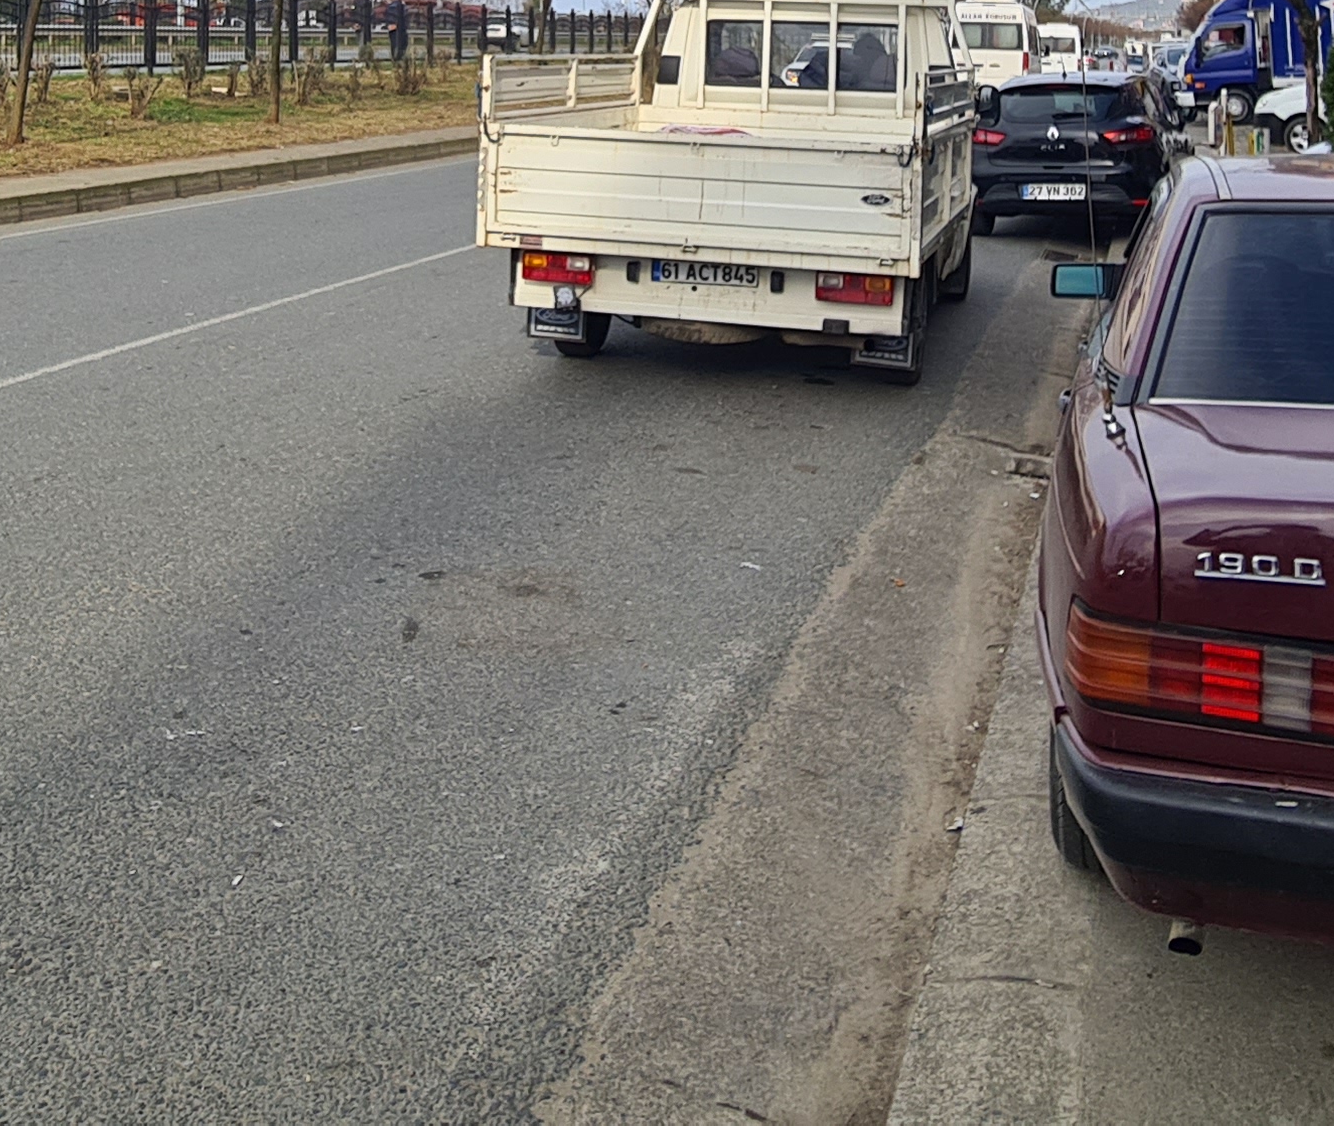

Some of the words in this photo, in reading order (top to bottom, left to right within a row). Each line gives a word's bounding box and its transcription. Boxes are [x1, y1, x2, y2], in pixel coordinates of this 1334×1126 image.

[1028, 186, 1043, 196] 27
[1046, 186, 1061, 196] VN
[661, 262, 679, 280] 61
[686, 263, 756, 284] ACT845
[1197, 551, 1280, 577] 190
[1294, 557, 1323, 580] D
